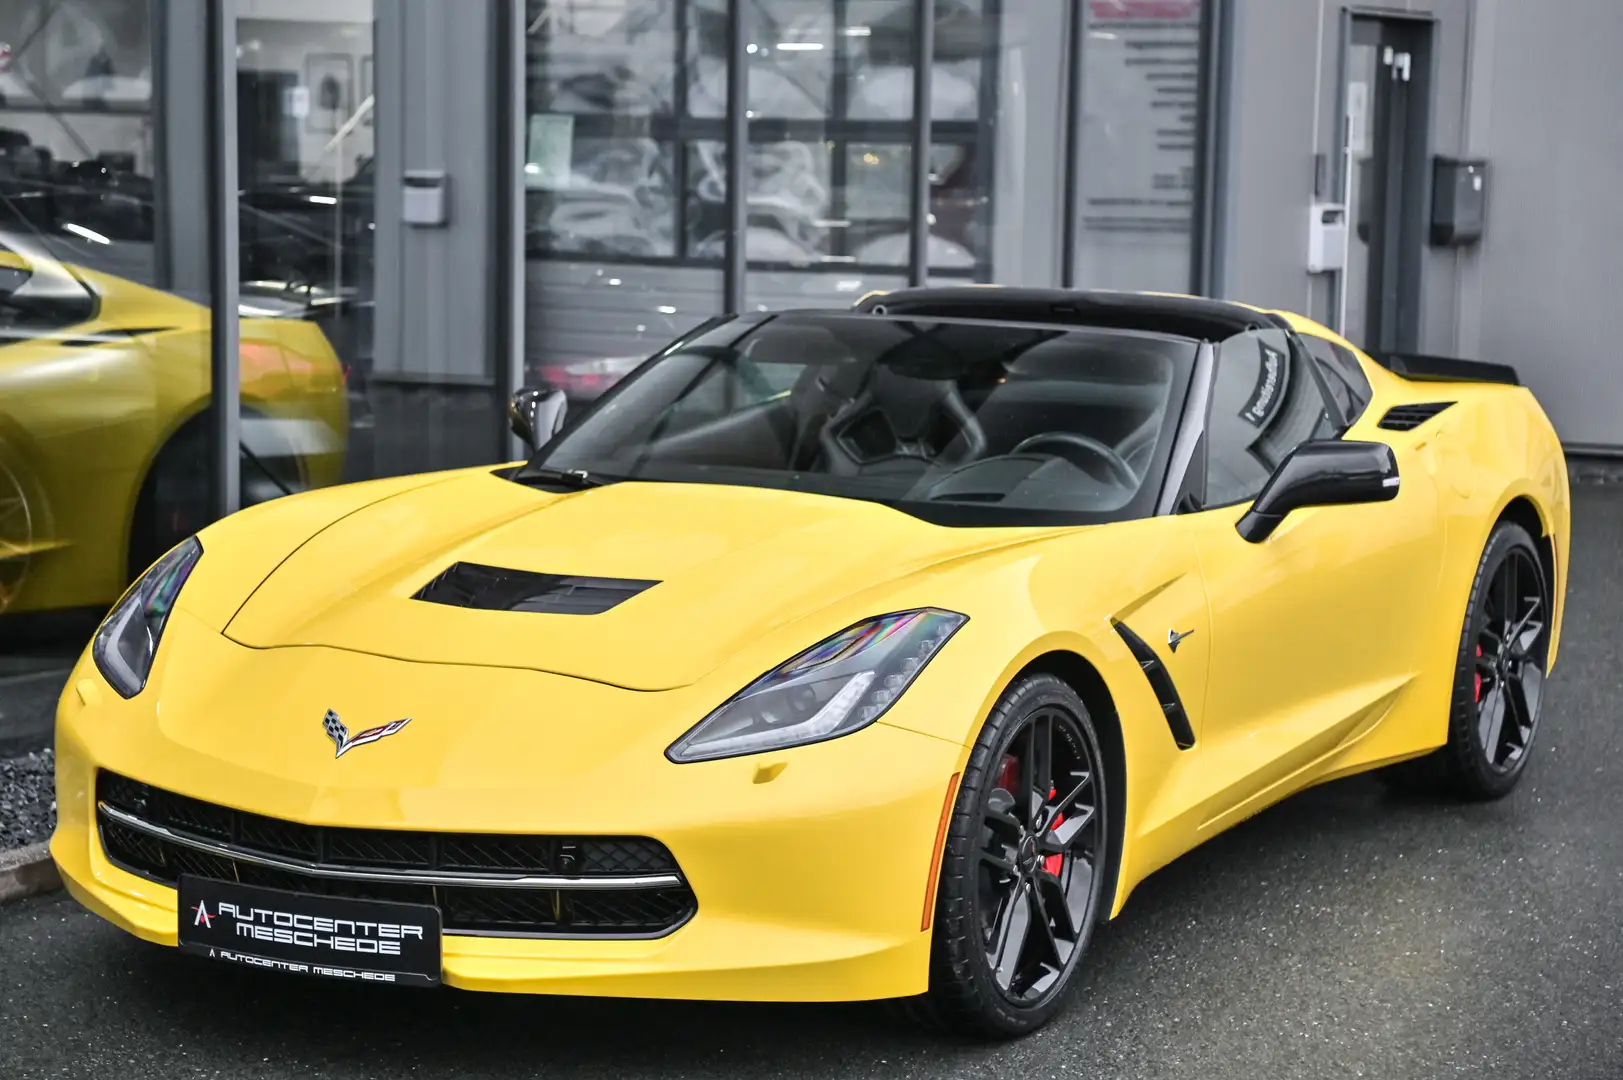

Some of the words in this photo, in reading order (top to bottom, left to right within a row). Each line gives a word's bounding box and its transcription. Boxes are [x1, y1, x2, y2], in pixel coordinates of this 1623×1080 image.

[218, 901, 423, 940] AUTOCENTER
[236, 922, 401, 955] MESCHEDE
[220, 950, 309, 973] AUTOCENTER
[313, 966, 396, 982] MESCHEDE
